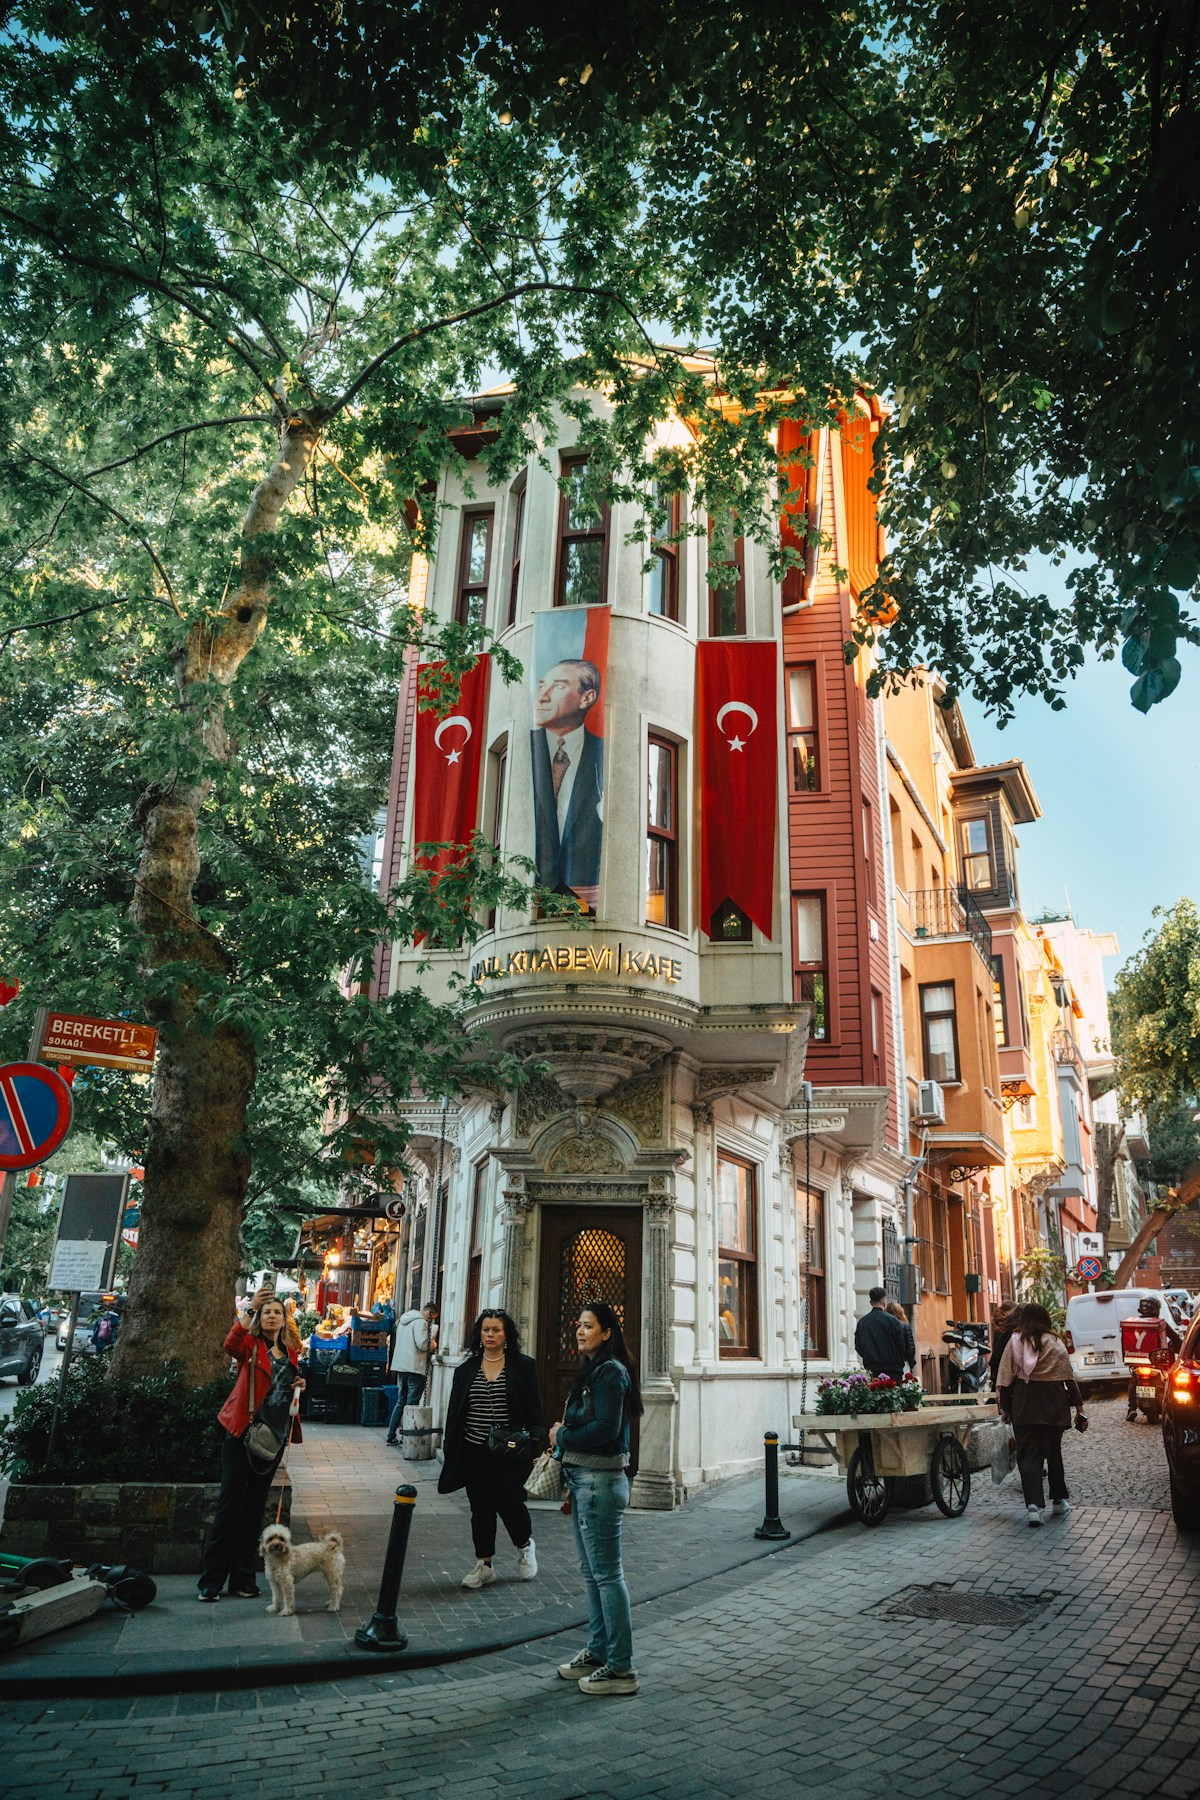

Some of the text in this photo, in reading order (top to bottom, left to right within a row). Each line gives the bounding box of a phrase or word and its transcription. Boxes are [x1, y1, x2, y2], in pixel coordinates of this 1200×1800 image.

[626, 950, 682, 981] KAFE
[52, 1019, 136, 1043] BEREKETLİ
[45, 1052, 72, 1061] ÜSKÜDAR
